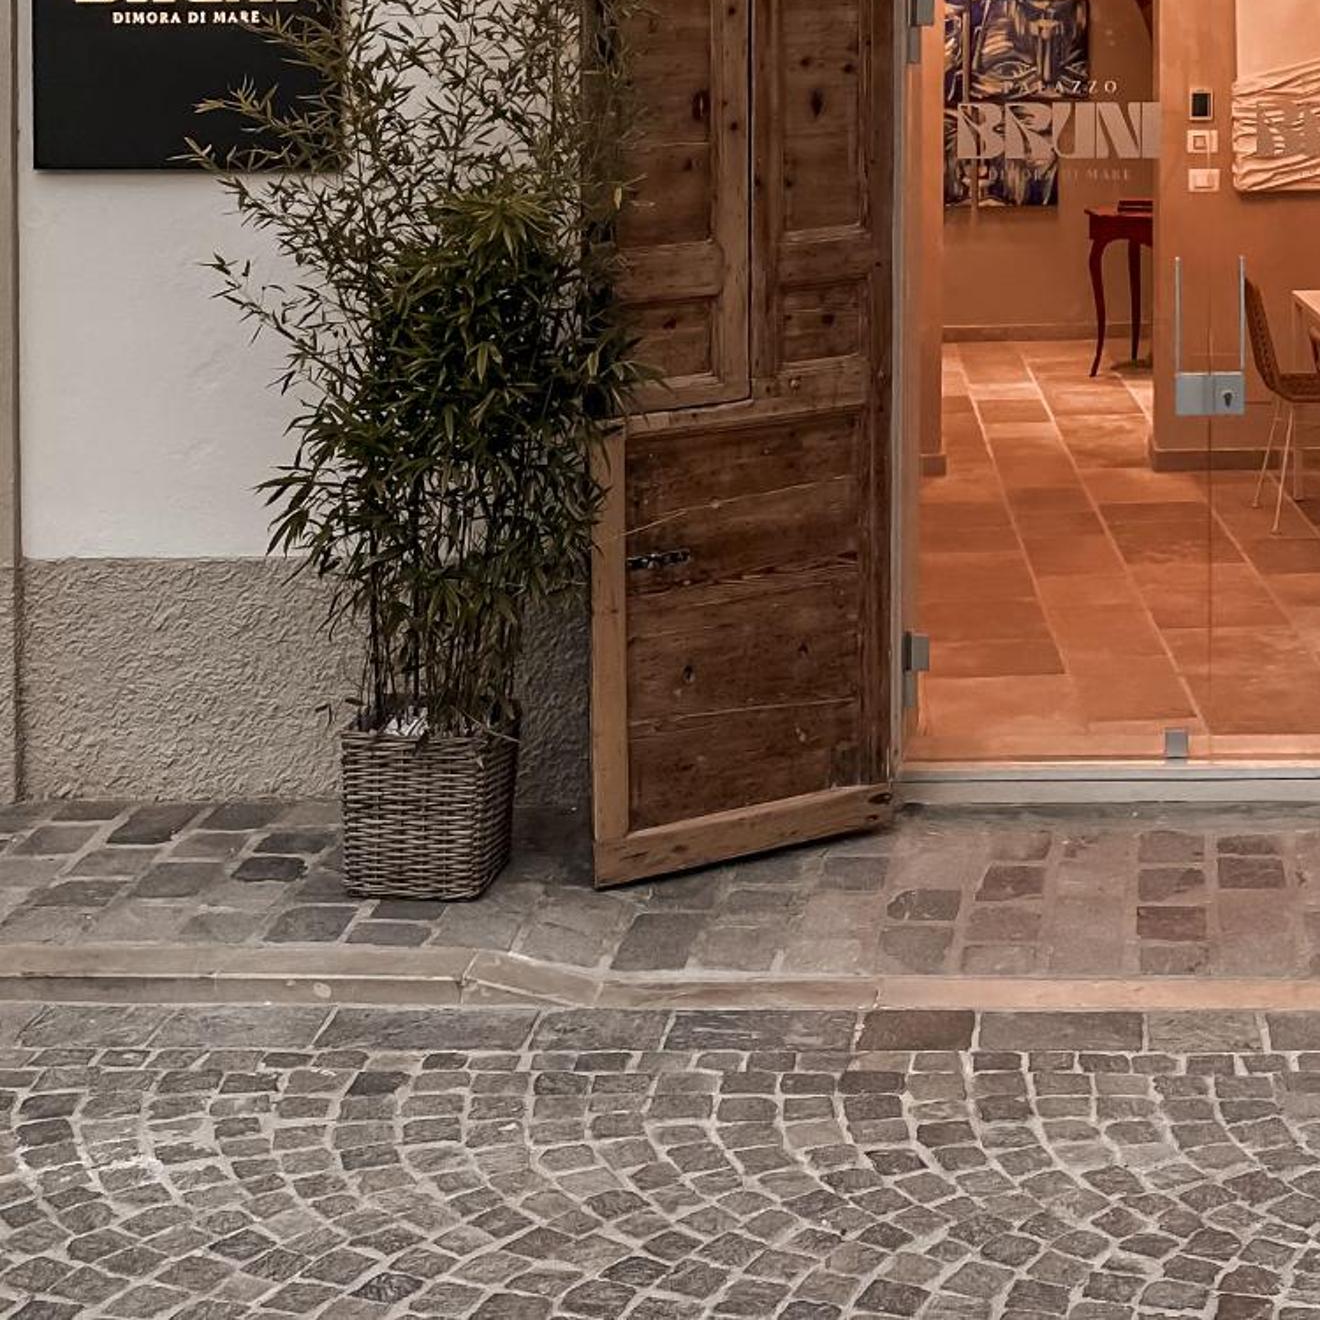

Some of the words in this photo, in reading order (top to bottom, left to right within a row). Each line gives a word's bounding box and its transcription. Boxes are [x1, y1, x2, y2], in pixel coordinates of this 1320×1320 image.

[112, 11, 181, 24] DIMORA
[187, 11, 206, 24] DI
[212, 11, 260, 24] MARE
[957, 102, 1161, 159] BRUNI
